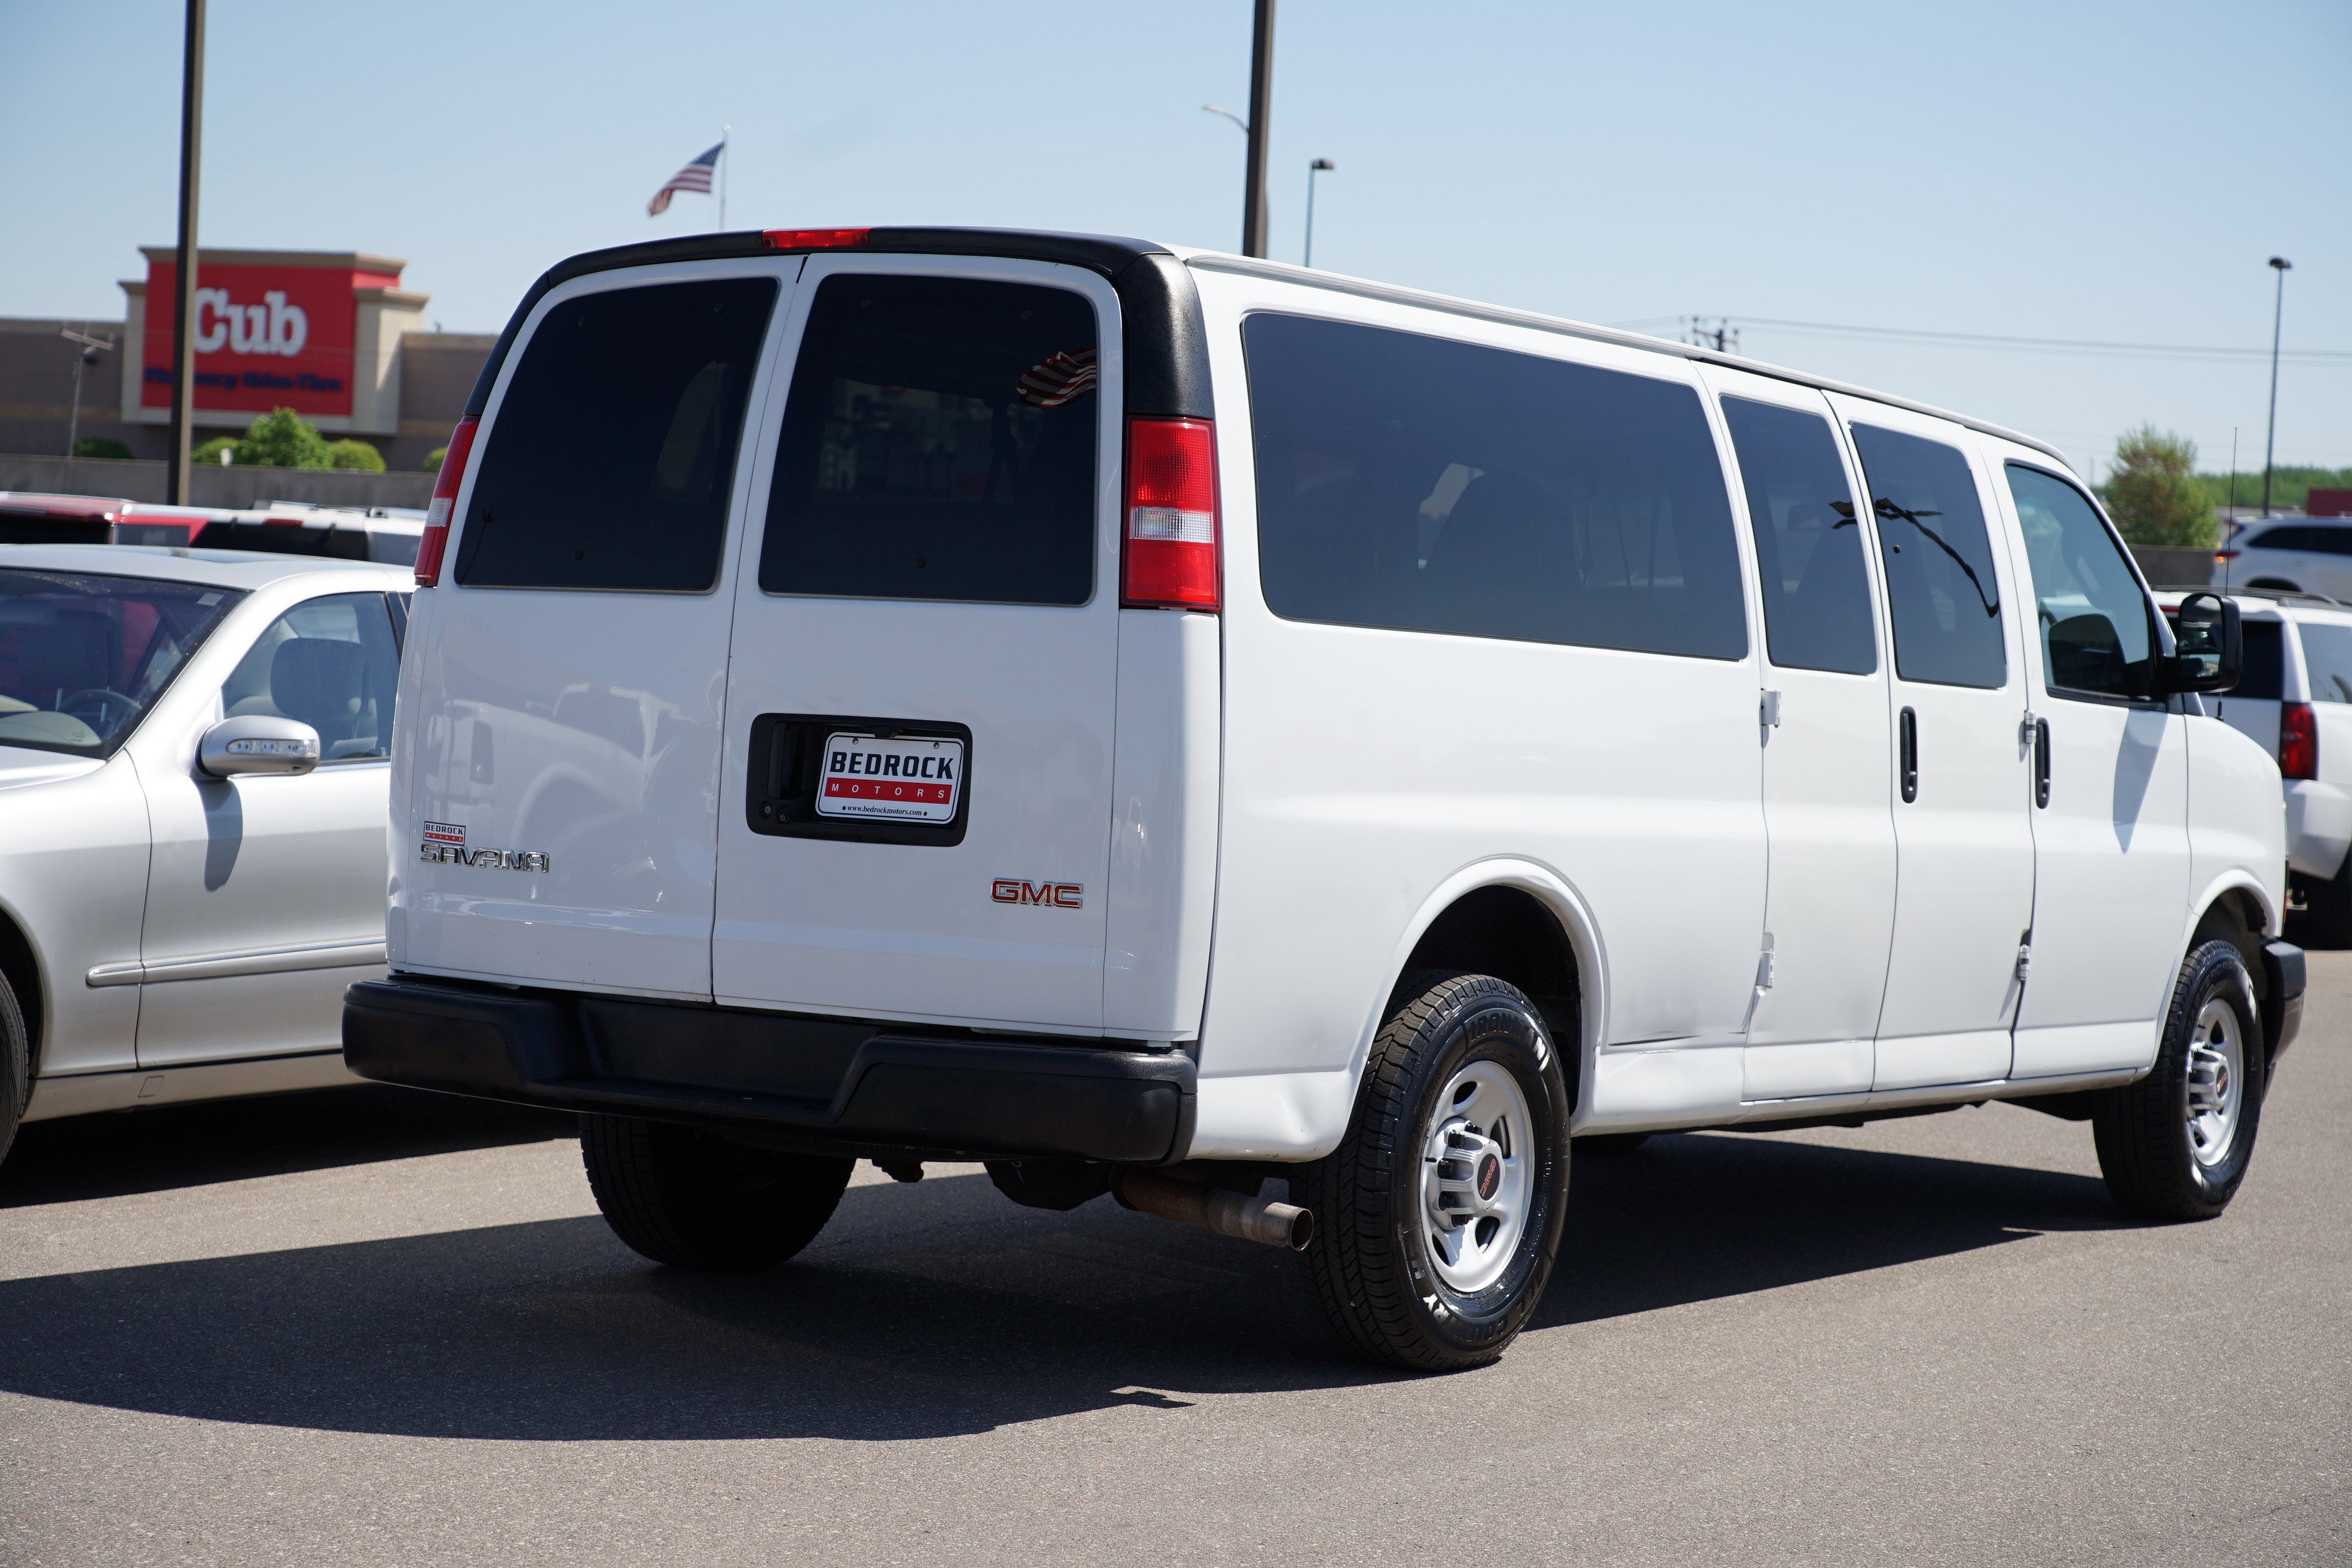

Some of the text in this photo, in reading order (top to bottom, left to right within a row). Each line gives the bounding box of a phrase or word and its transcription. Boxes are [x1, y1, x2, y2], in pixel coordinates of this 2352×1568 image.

[194, 287, 308, 357] Cub
[829, 751, 954, 779] BEDROCK
[831, 783, 945, 799] MOTORS
[847, 805, 922, 816] www.bedrockmotors.com
[425, 824, 464, 835] BEDROCK
[426, 833, 462, 841] MOTORS
[420, 843, 550, 874] SAVANA
[990, 877, 1083, 909] GMC
[1480, 1158, 1497, 1197] GMC
